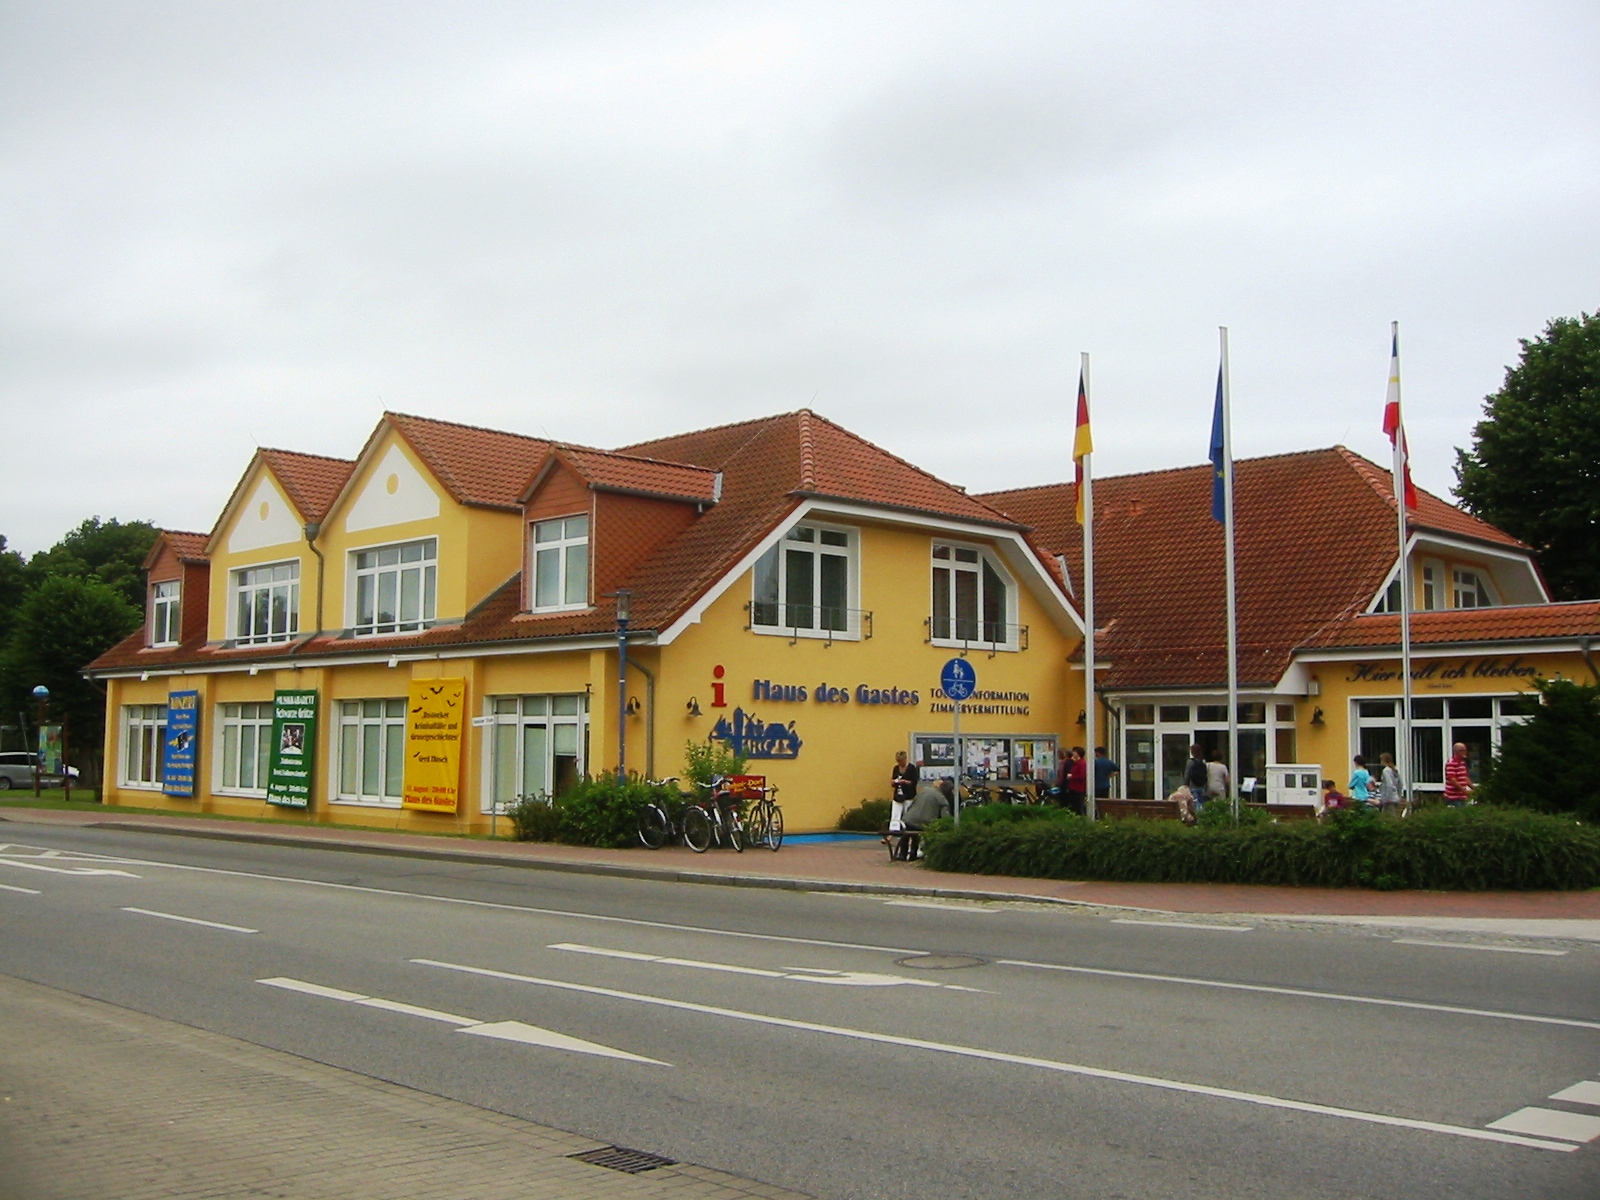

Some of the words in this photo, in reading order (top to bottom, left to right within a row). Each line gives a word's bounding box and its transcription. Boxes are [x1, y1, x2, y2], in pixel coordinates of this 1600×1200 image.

[1345, 663, 1396, 682] Hier
[1397, 661, 1443, 680] will
[1441, 660, 1473, 679] ich
[711, 664, 727, 707] i
[753, 679, 808, 702] Haus
[814, 682, 850, 704] des
[856, 683, 920, 706] Gastes
[404, 795, 421, 803] Haus
[421, 796, 432, 804] des
[433, 796, 456, 806] Gastes
